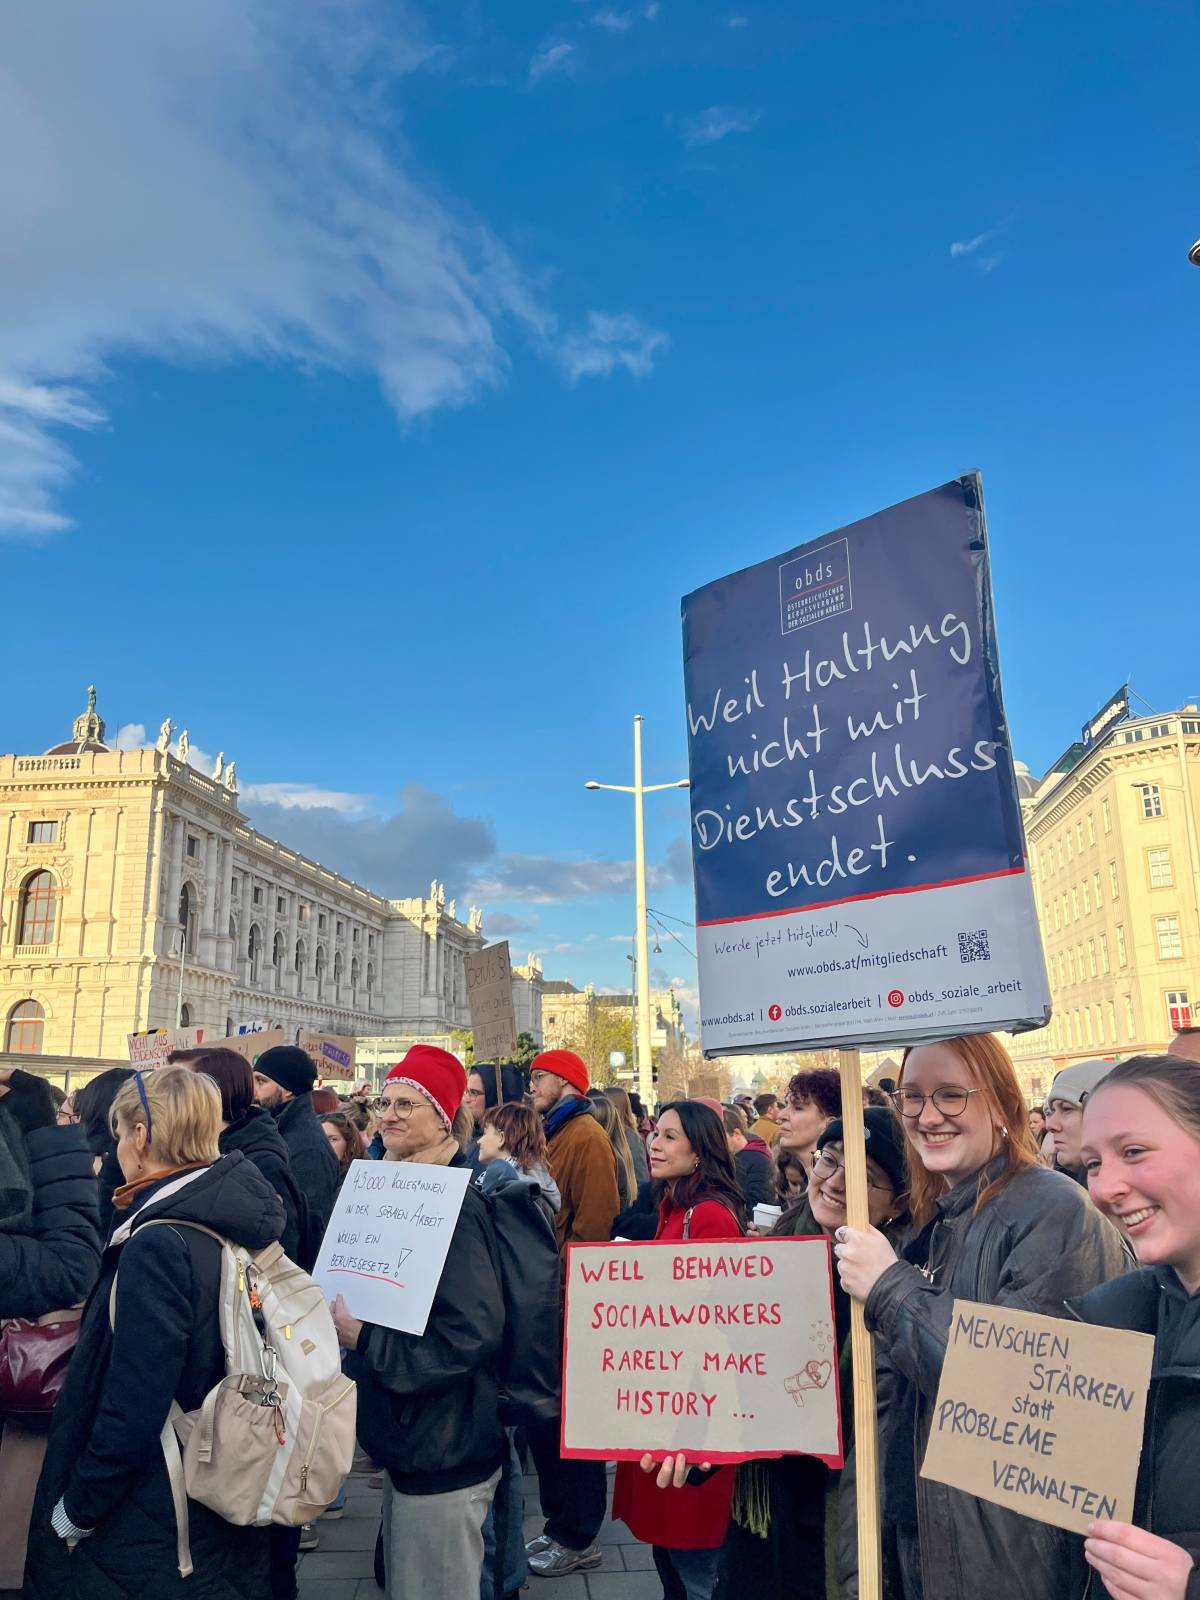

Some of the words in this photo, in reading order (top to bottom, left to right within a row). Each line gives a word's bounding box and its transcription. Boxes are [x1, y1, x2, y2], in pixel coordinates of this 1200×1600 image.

[795, 562, 833, 590] obds
[787, 593, 845, 621] BERUFSVERBAND
[787, 619, 799, 630] DER
[799, 608, 825, 623] SOZIALEN
[825, 602, 845, 616] ARBEIT
[688, 669, 765, 736] Weil
[782, 613, 971, 699] Haltung
[727, 704, 829, 777] nicht
[848, 669, 928, 740] mit
[695, 740, 997, 850] Dienstschluss
[766, 814, 917, 897] endet.
[714, 938, 752, 955] Werde
[755, 929, 781, 959] jetzt
[788, 921, 838, 948] Mitglied!
[788, 944, 948, 978] www.obds.at/mitgliedschaft
[701, 1011, 755, 1027] www.obds.at
[785, 996, 872, 1018] obds.sozialearbeit
[908, 979, 1022, 1004] obds_soziale_arbeit
[365, 1233, 381, 1244] EIN
[580, 1259, 645, 1284] WELL
[672, 1255, 774, 1281] BEHAVED
[591, 1302, 782, 1330] SOCIALWORKERS
[954, 1313, 1069, 1360] MENSCHEN
[602, 1348, 684, 1373] RARELY
[703, 1351, 768, 1376] MAKE
[616, 1388, 718, 1417] HISTORY
[1029, 1363, 1135, 1412] STÄRKEN
[1011, 1393, 1055, 1421] statt
[938, 1399, 1057, 1456] PROBLEME
[992, 1460, 1117, 1521] VERWALTEN
